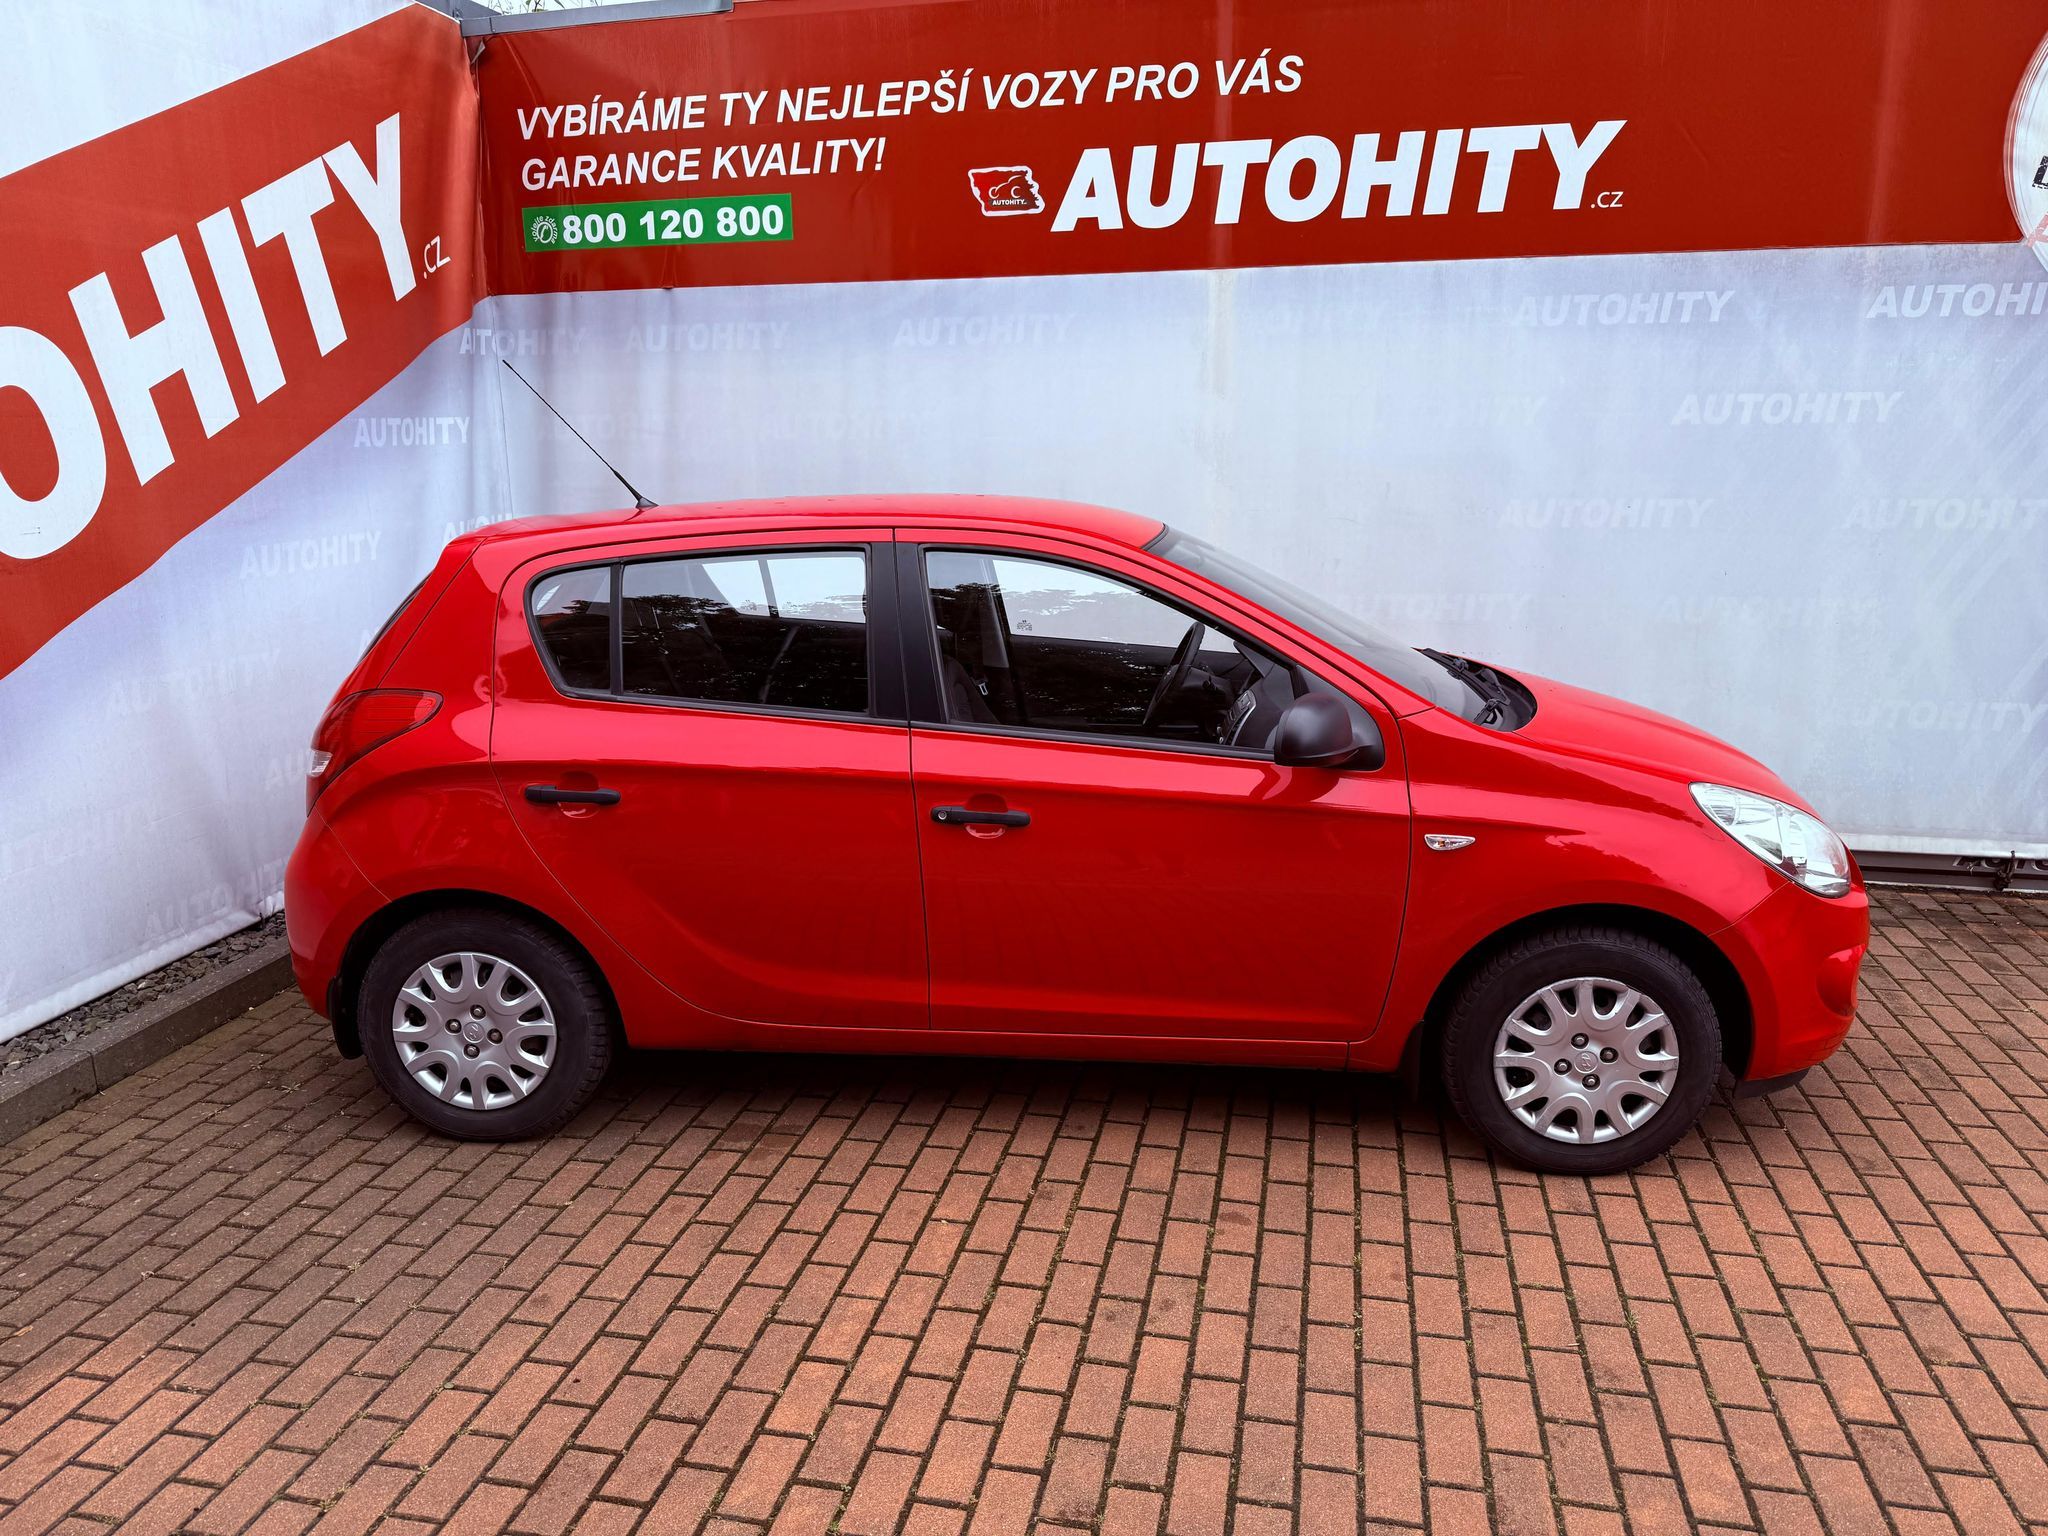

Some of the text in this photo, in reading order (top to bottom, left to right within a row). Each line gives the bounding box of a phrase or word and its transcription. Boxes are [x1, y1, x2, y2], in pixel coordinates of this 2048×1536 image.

[516, 48, 1305, 141] VYBÍRÁME TY NEJLEPŠÍ VOZY PRO VÁS
[521, 136, 887, 191] GARANCE KVALITY!
[561, 203, 784, 245] 800 120 800
[1513, 290, 1736, 328] AUTOHITY
[1671, 390, 1904, 427] AUTOHITY
[353, 416, 470, 449] AUTOHITY
[239, 529, 382, 580] AUTOHITY
